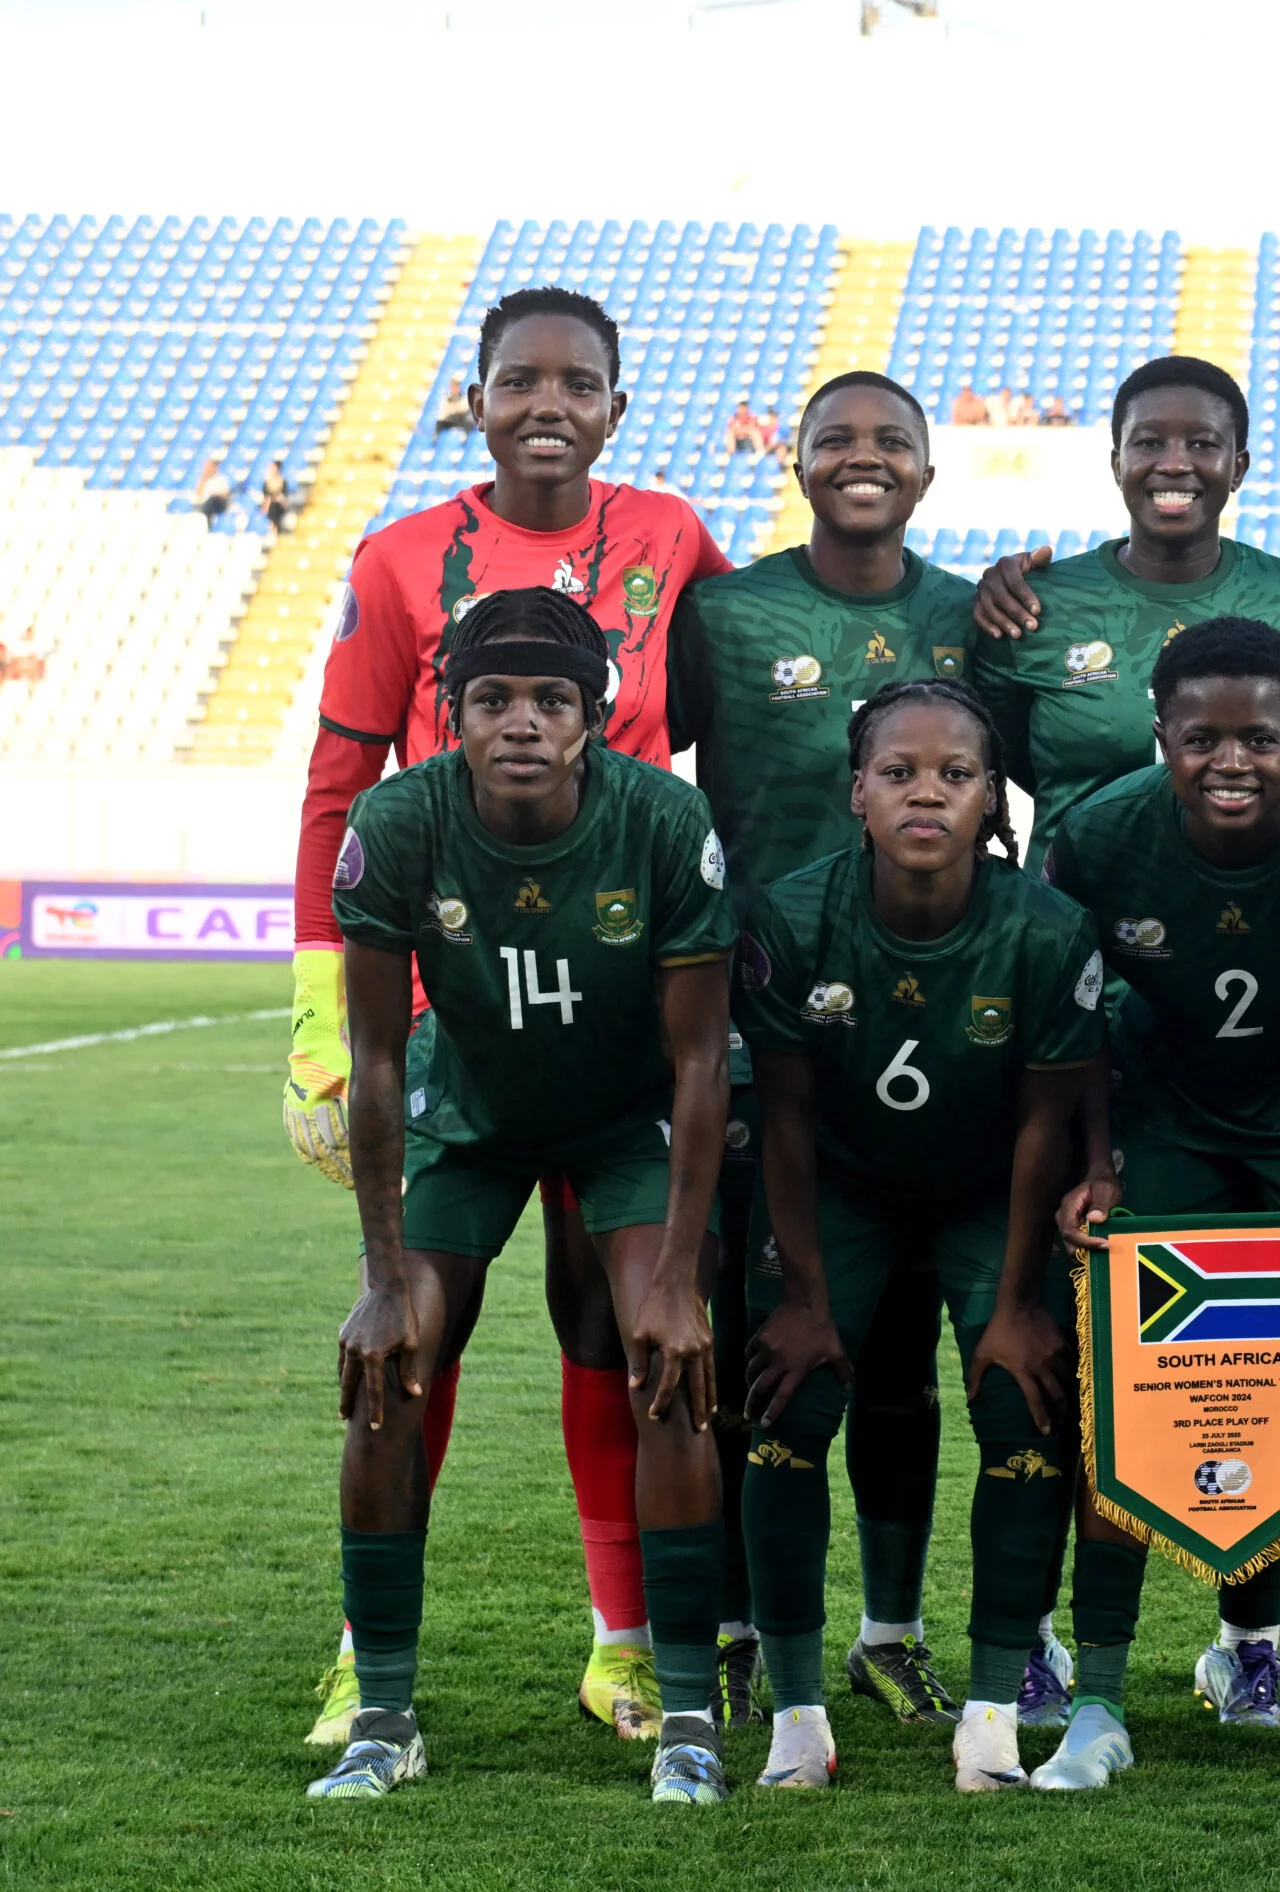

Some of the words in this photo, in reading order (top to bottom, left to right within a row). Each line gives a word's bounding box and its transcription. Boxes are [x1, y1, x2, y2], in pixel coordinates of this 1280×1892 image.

[146, 907, 291, 940] CAF
[500, 947, 582, 1029] 14
[1214, 969, 1263, 1038] 2
[876, 1039, 930, 1111] 6
[1157, 1354, 1216, 1368] SOUTH
[1134, 1382, 1171, 1392] SENIOR
[1174, 1380, 1222, 1390] WOMEN'S
[1226, 1378, 1276, 1388] NATIONAL
[1190, 1394, 1229, 1403] WAFCON
[1174, 1420, 1191, 1428] 3RD
[1194, 1418, 1223, 1427] PLACE
[1226, 1418, 1249, 1426] PLAY
[1251, 1417, 1269, 1425] OFF
